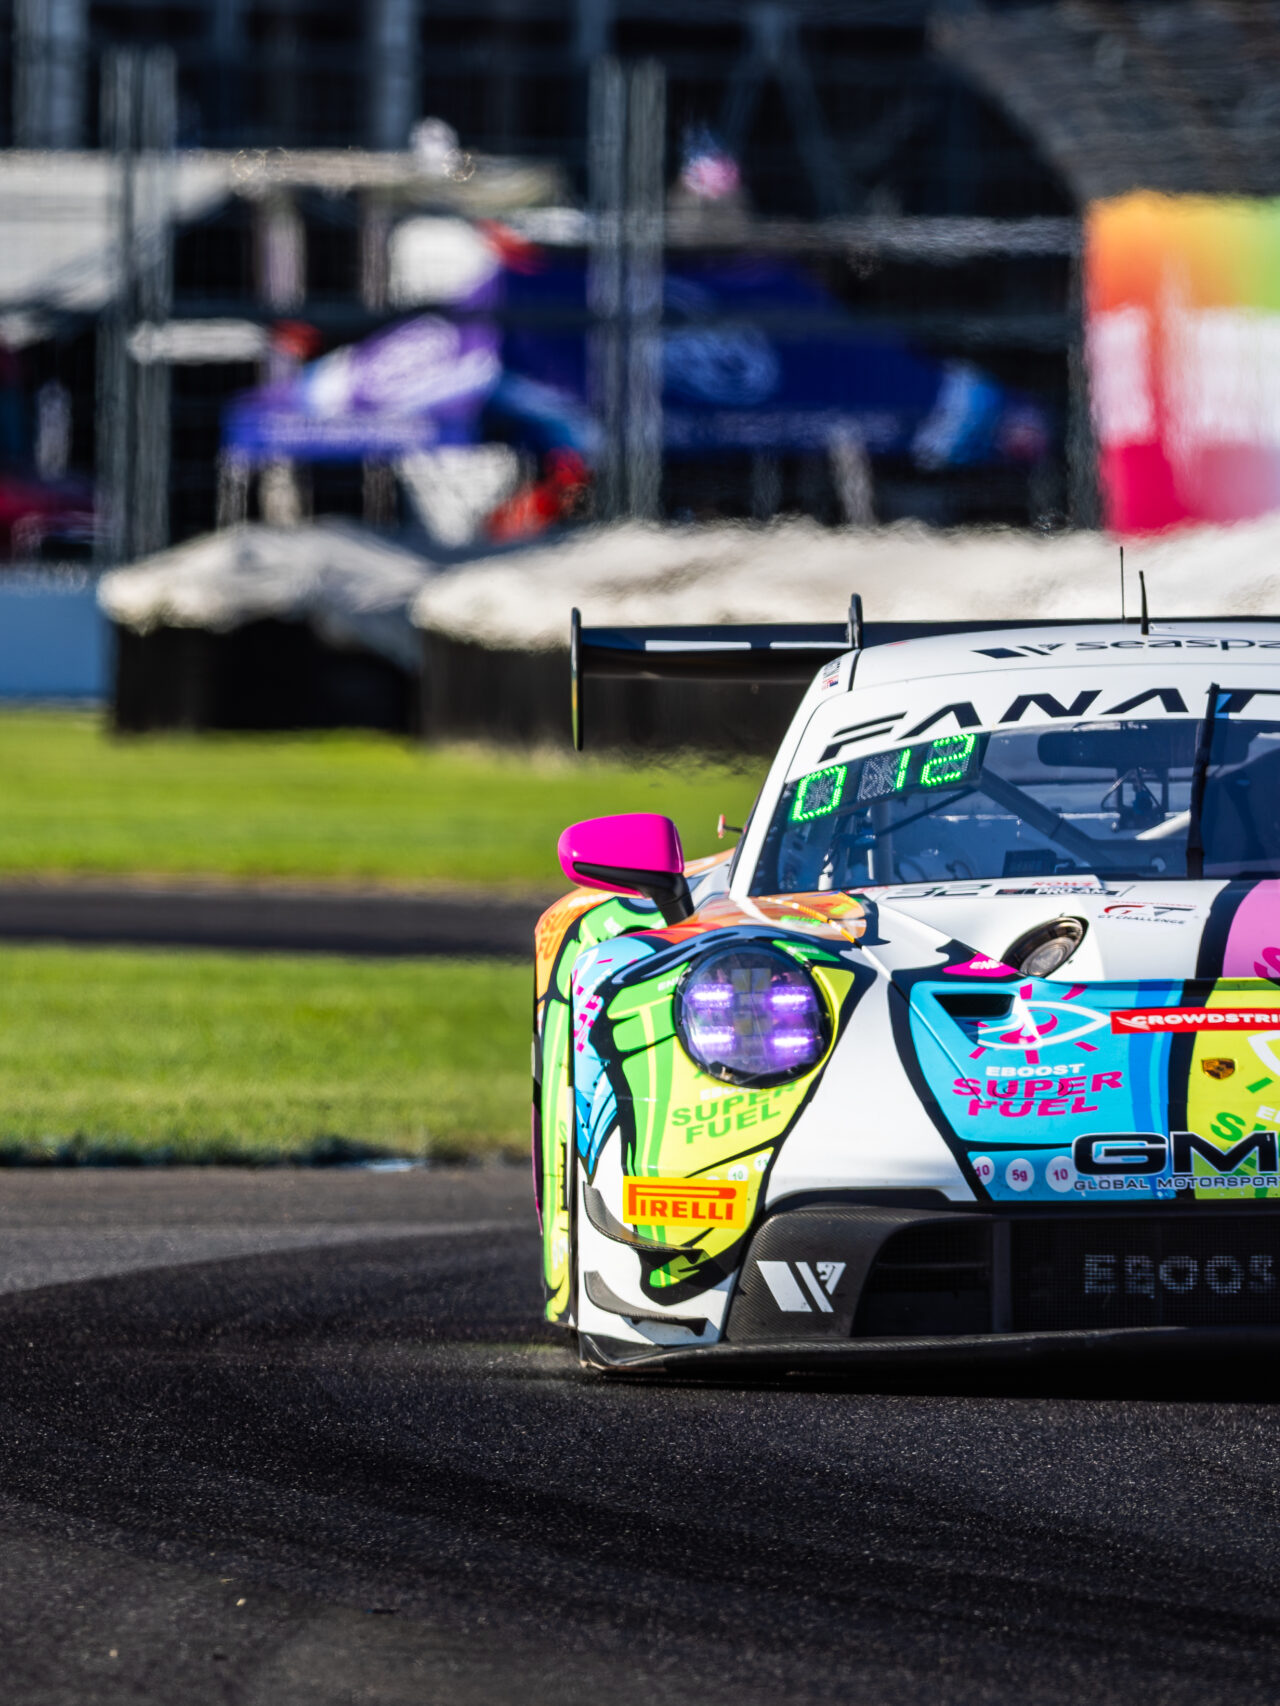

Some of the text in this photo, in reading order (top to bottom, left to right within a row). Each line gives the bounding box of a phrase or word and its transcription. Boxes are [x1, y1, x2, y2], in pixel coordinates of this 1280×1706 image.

[985, 1063, 1086, 1077] EBOOST
[952, 1071, 1123, 1099] SUPER
[968, 1096, 1099, 1118] FUEL
[685, 1103, 782, 1144] FUEL
[1053, 1168, 1069, 1181] 10
[1074, 1178, 1150, 1191] GLOBAL
[628, 1183, 736, 1221] PIRELLI
